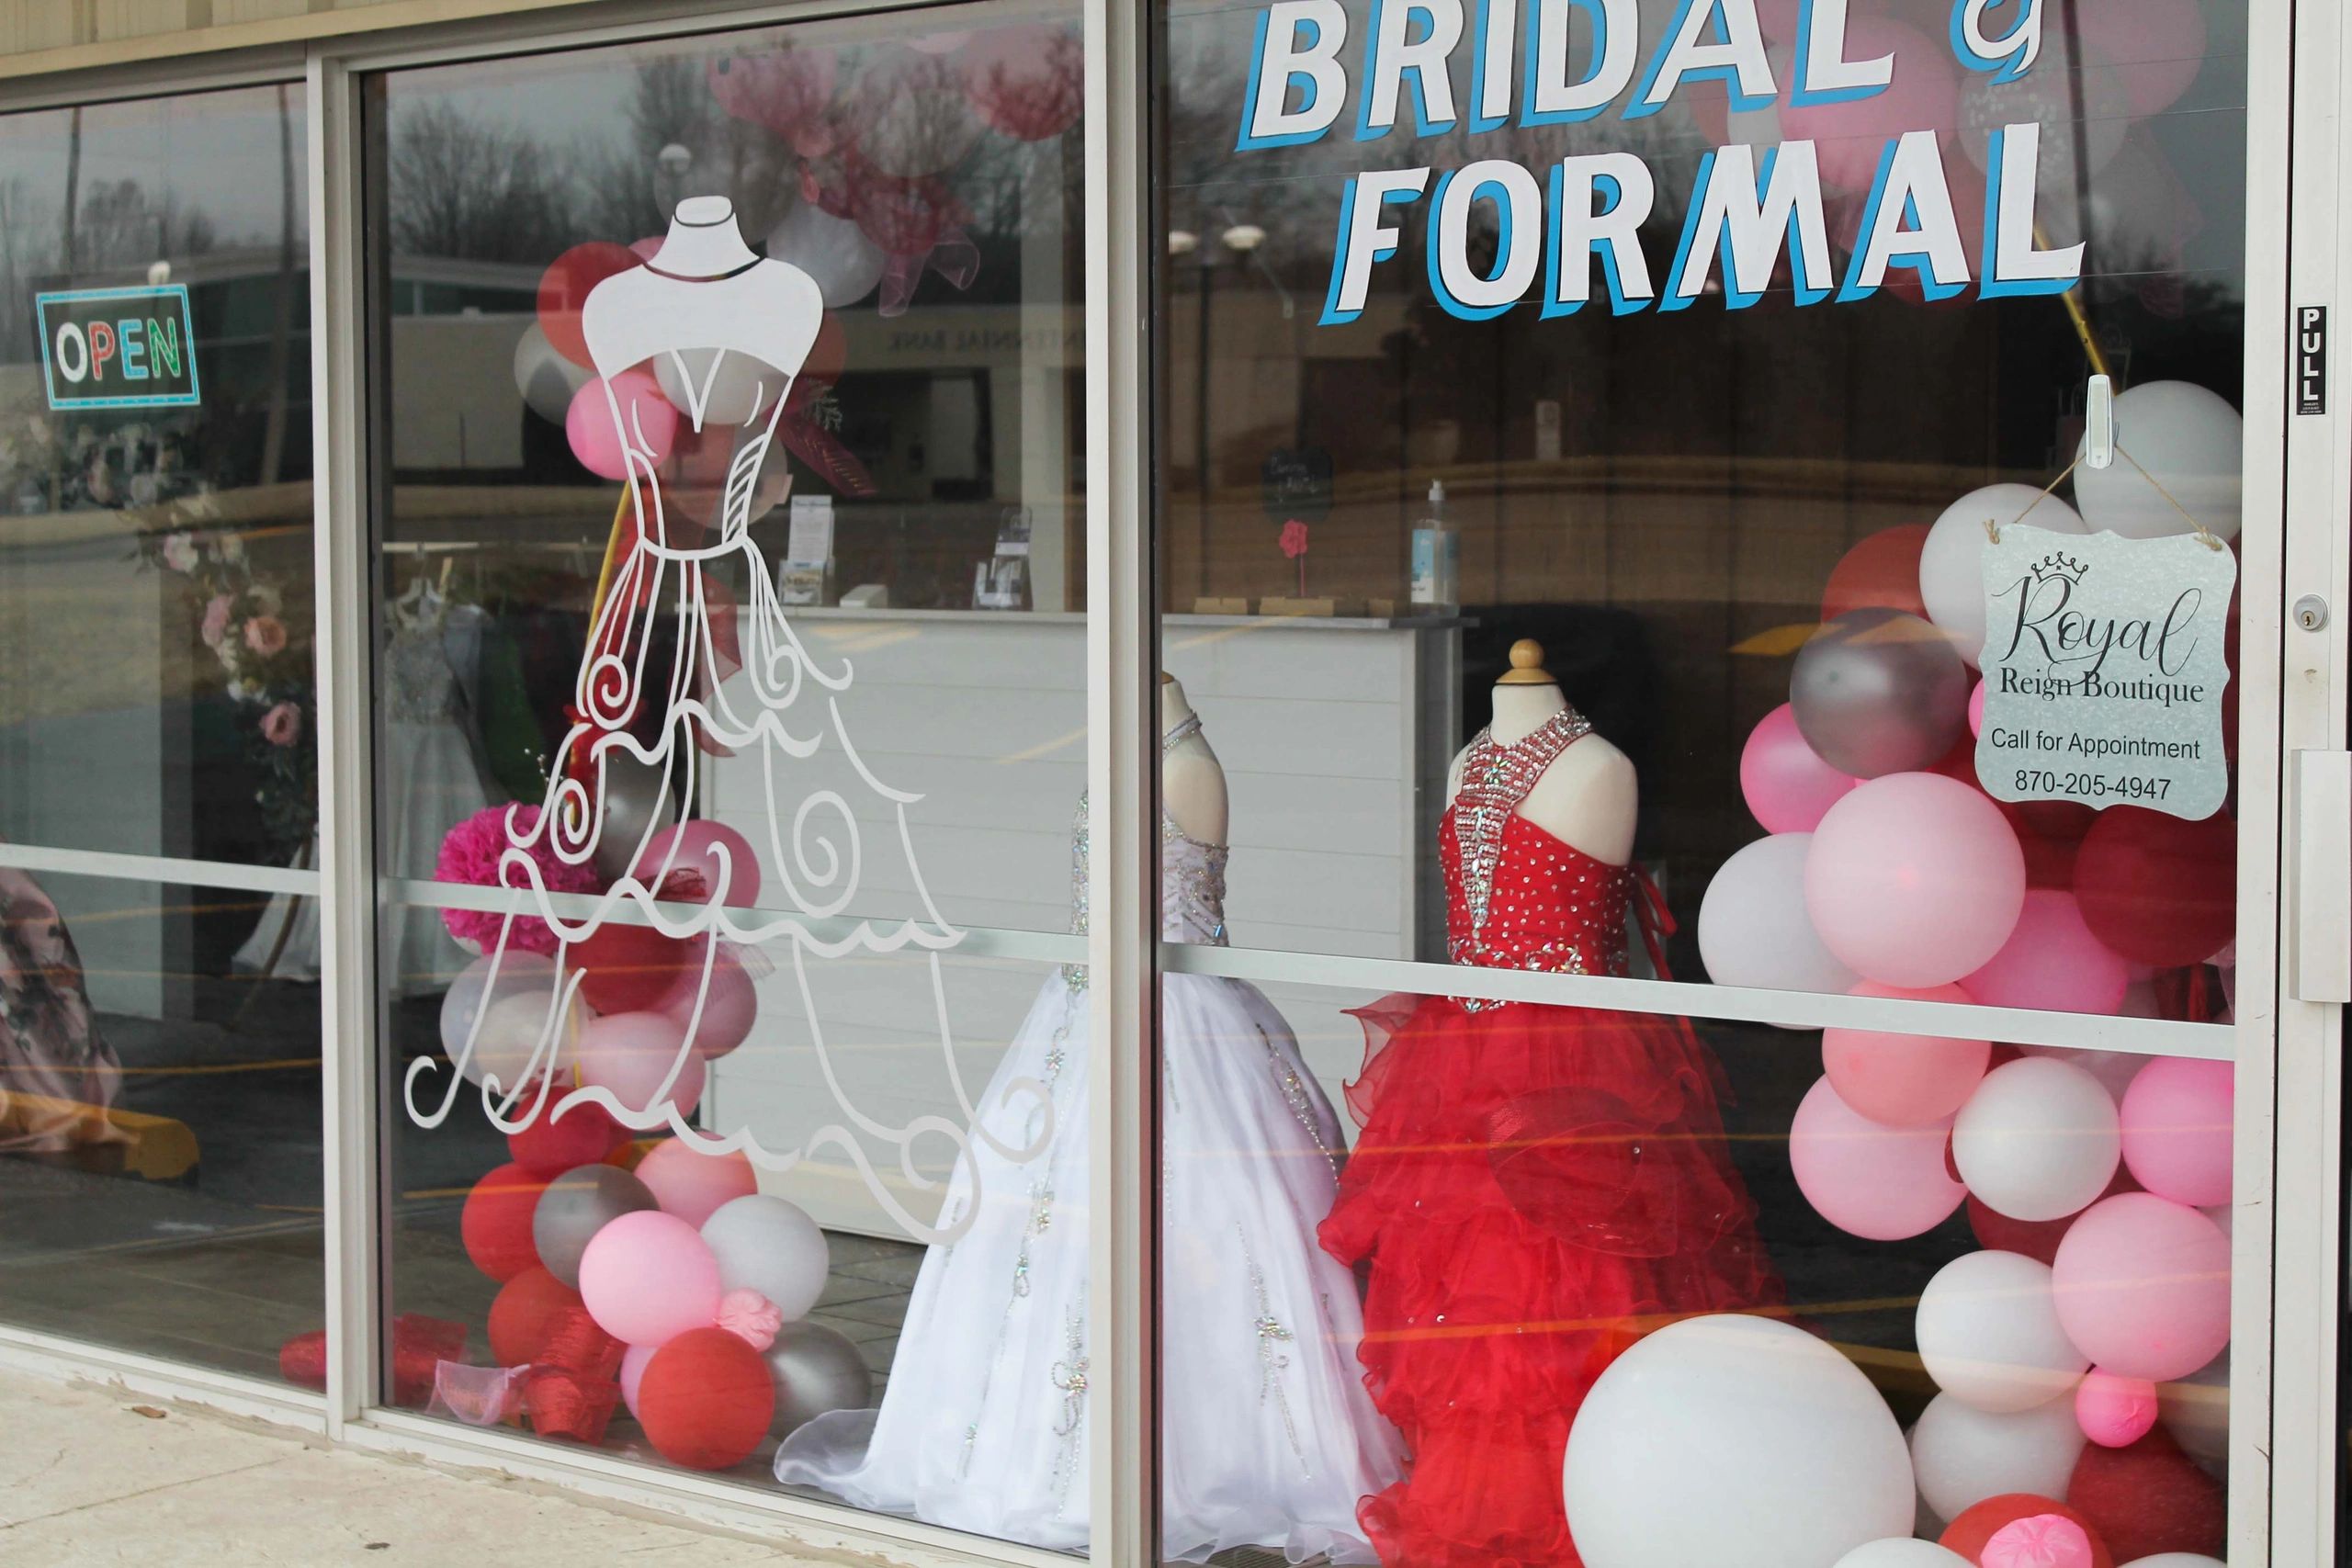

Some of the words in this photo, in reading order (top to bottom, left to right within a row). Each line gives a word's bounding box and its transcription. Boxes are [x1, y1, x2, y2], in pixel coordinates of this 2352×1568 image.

[1235, 0, 1895, 152] BRIDAL
[1318, 123, 2086, 326] FORMAL
[56, 317, 181, 383] OPEN
[2301, 309, 2320, 401] PULL
[1991, 576, 2202, 687] Royal
[2000, 667, 2072, 701] Reign
[2082, 671, 2204, 707] Boutique
[1991, 728, 2030, 750] Call
[2036, 730, 2064, 751] for
[2068, 732, 2201, 759] Appointment
[2015, 770, 2172, 800] 870-205-4947
